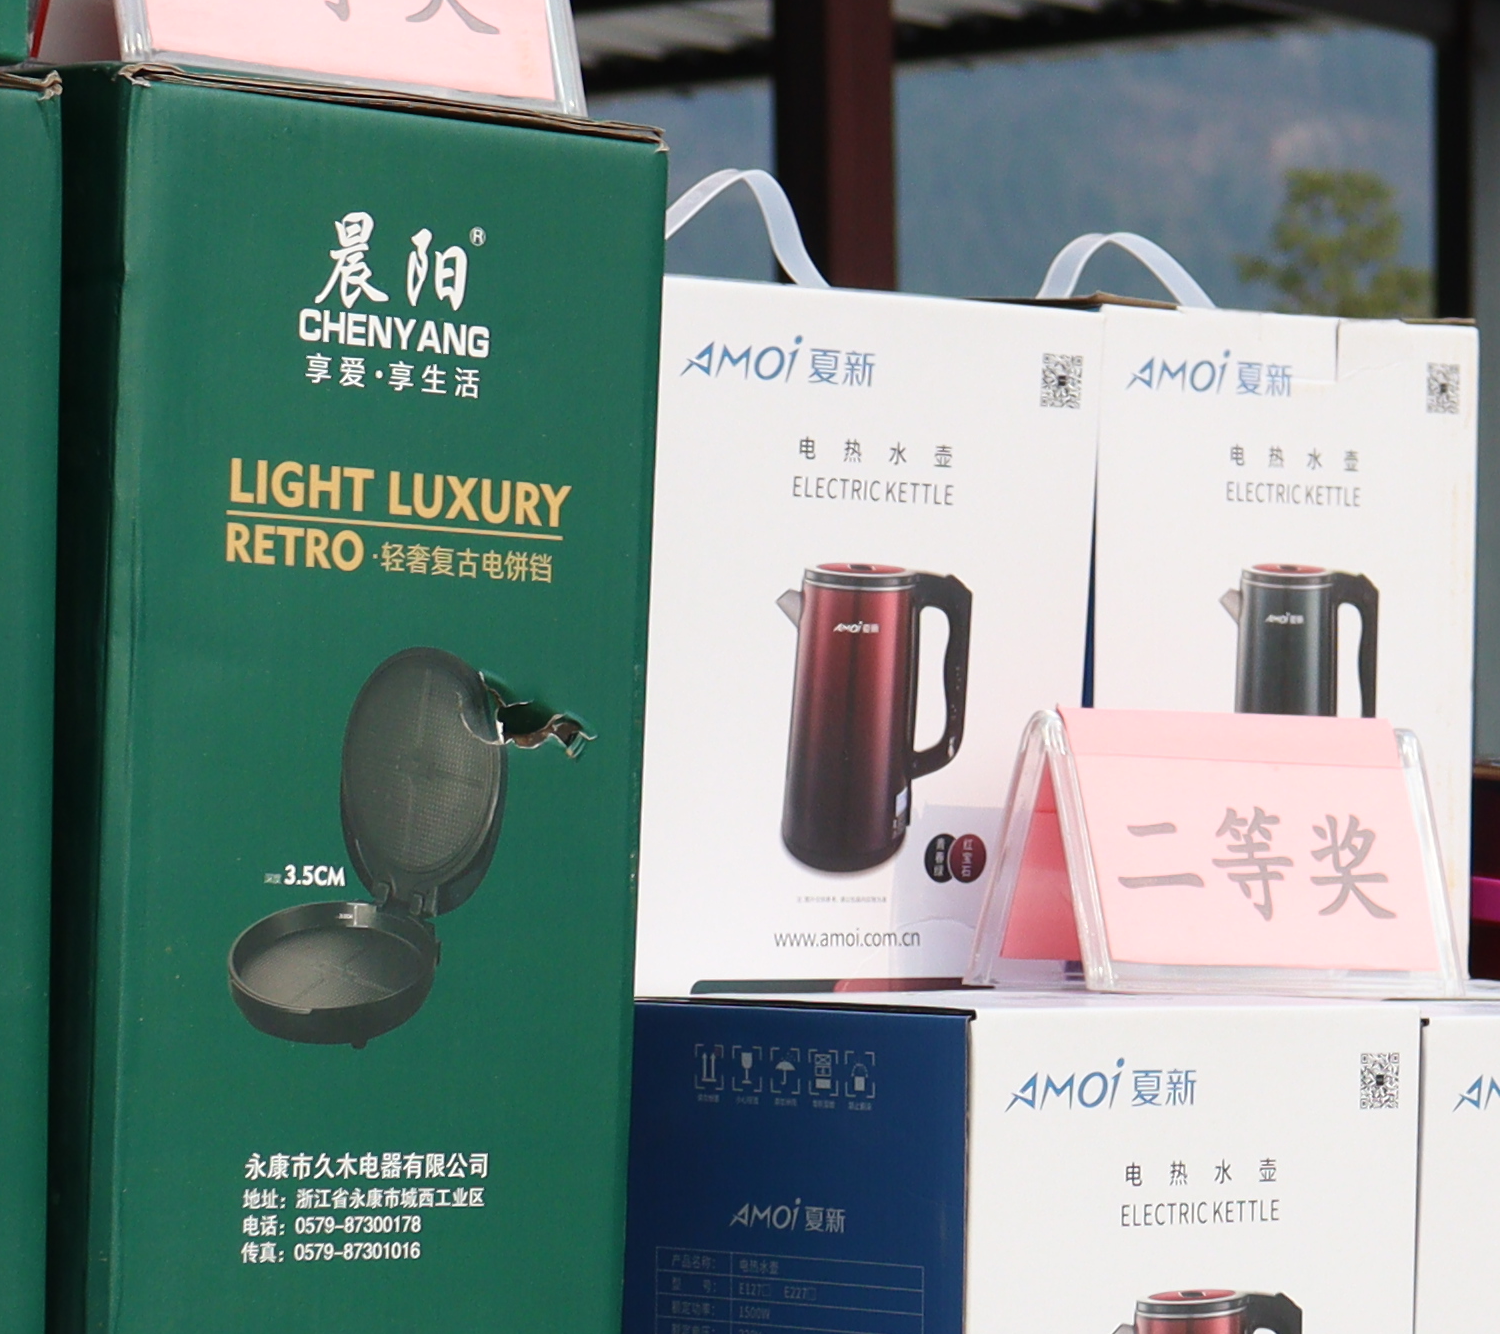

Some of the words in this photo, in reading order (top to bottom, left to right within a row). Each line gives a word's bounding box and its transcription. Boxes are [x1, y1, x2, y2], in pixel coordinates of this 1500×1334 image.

[314, 212, 468, 310] 晨阳
[299, 308, 490, 358] CHENYANG
[305, 353, 480, 399] 享爱·享生活
[808, 348, 876, 388] 夏新
[1235, 360, 1293, 397] 夏新
[798, 436, 954, 468] 电热水壶
[1230, 443, 1360, 473] 电热水壶
[230, 457, 375, 512] LIGHT
[388, 471, 572, 527] LUXURY
[793, 475, 881, 503] ELECTRIC
[884, 479, 955, 507] KETTLE
[1225, 480, 1301, 506] ELECTRIC
[1304, 483, 1361, 509] KETTLE
[225, 522, 365, 572] RETRO
[283, 865, 345, 887] 3.5CM
[1117, 806, 1397, 922] 二等奖
[774, 927, 921, 950] www.amoi.com.cn
[1131, 1067, 1198, 1108] 夏新
[244, 1152, 489, 1180] 永康市久木电器有限公司
[1124, 1157, 1278, 1189] 电热水壶
[805, 1206, 845, 1233] 夏新
[1120, 1201, 1209, 1227] ELECTRIC
[1212, 1198, 1280, 1223] KETTLE
